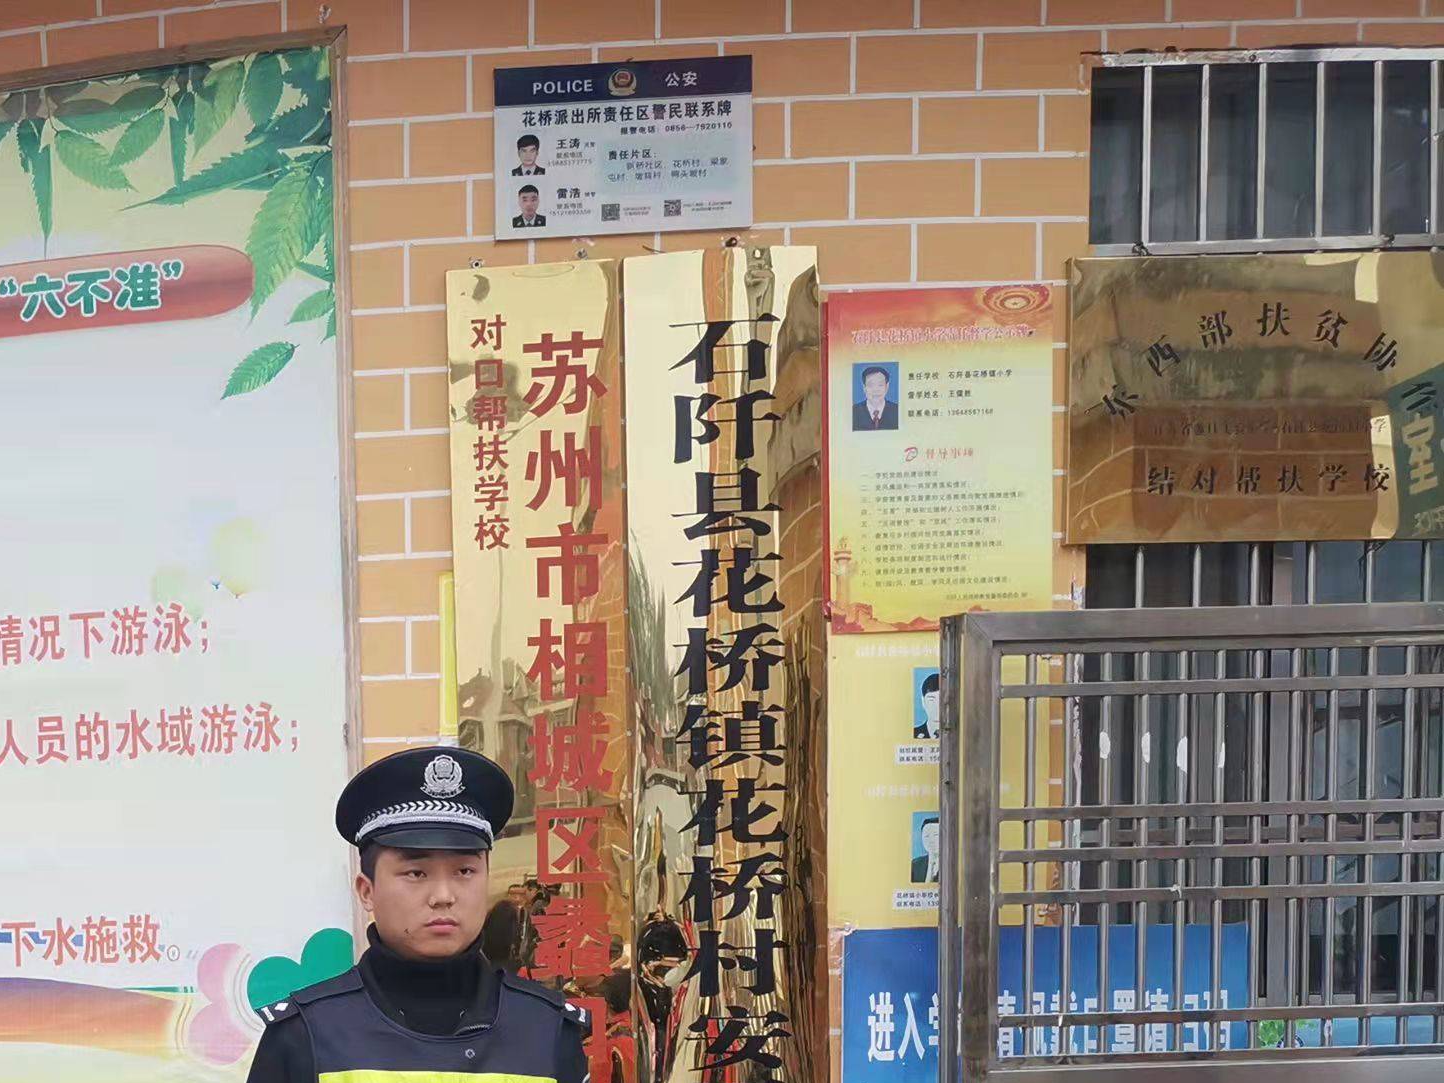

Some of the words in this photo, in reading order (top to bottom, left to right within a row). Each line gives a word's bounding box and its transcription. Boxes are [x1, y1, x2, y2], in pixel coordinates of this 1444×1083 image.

[532, 79, 594, 96] POLICE
[664, 70, 699, 88] 公安
[521, 99, 733, 127] 花桥派出所责任区警民联系牌
[470, 313, 511, 551] 对口帮扶学校
[1147, 463, 1391, 496] 结对帮扶学校
